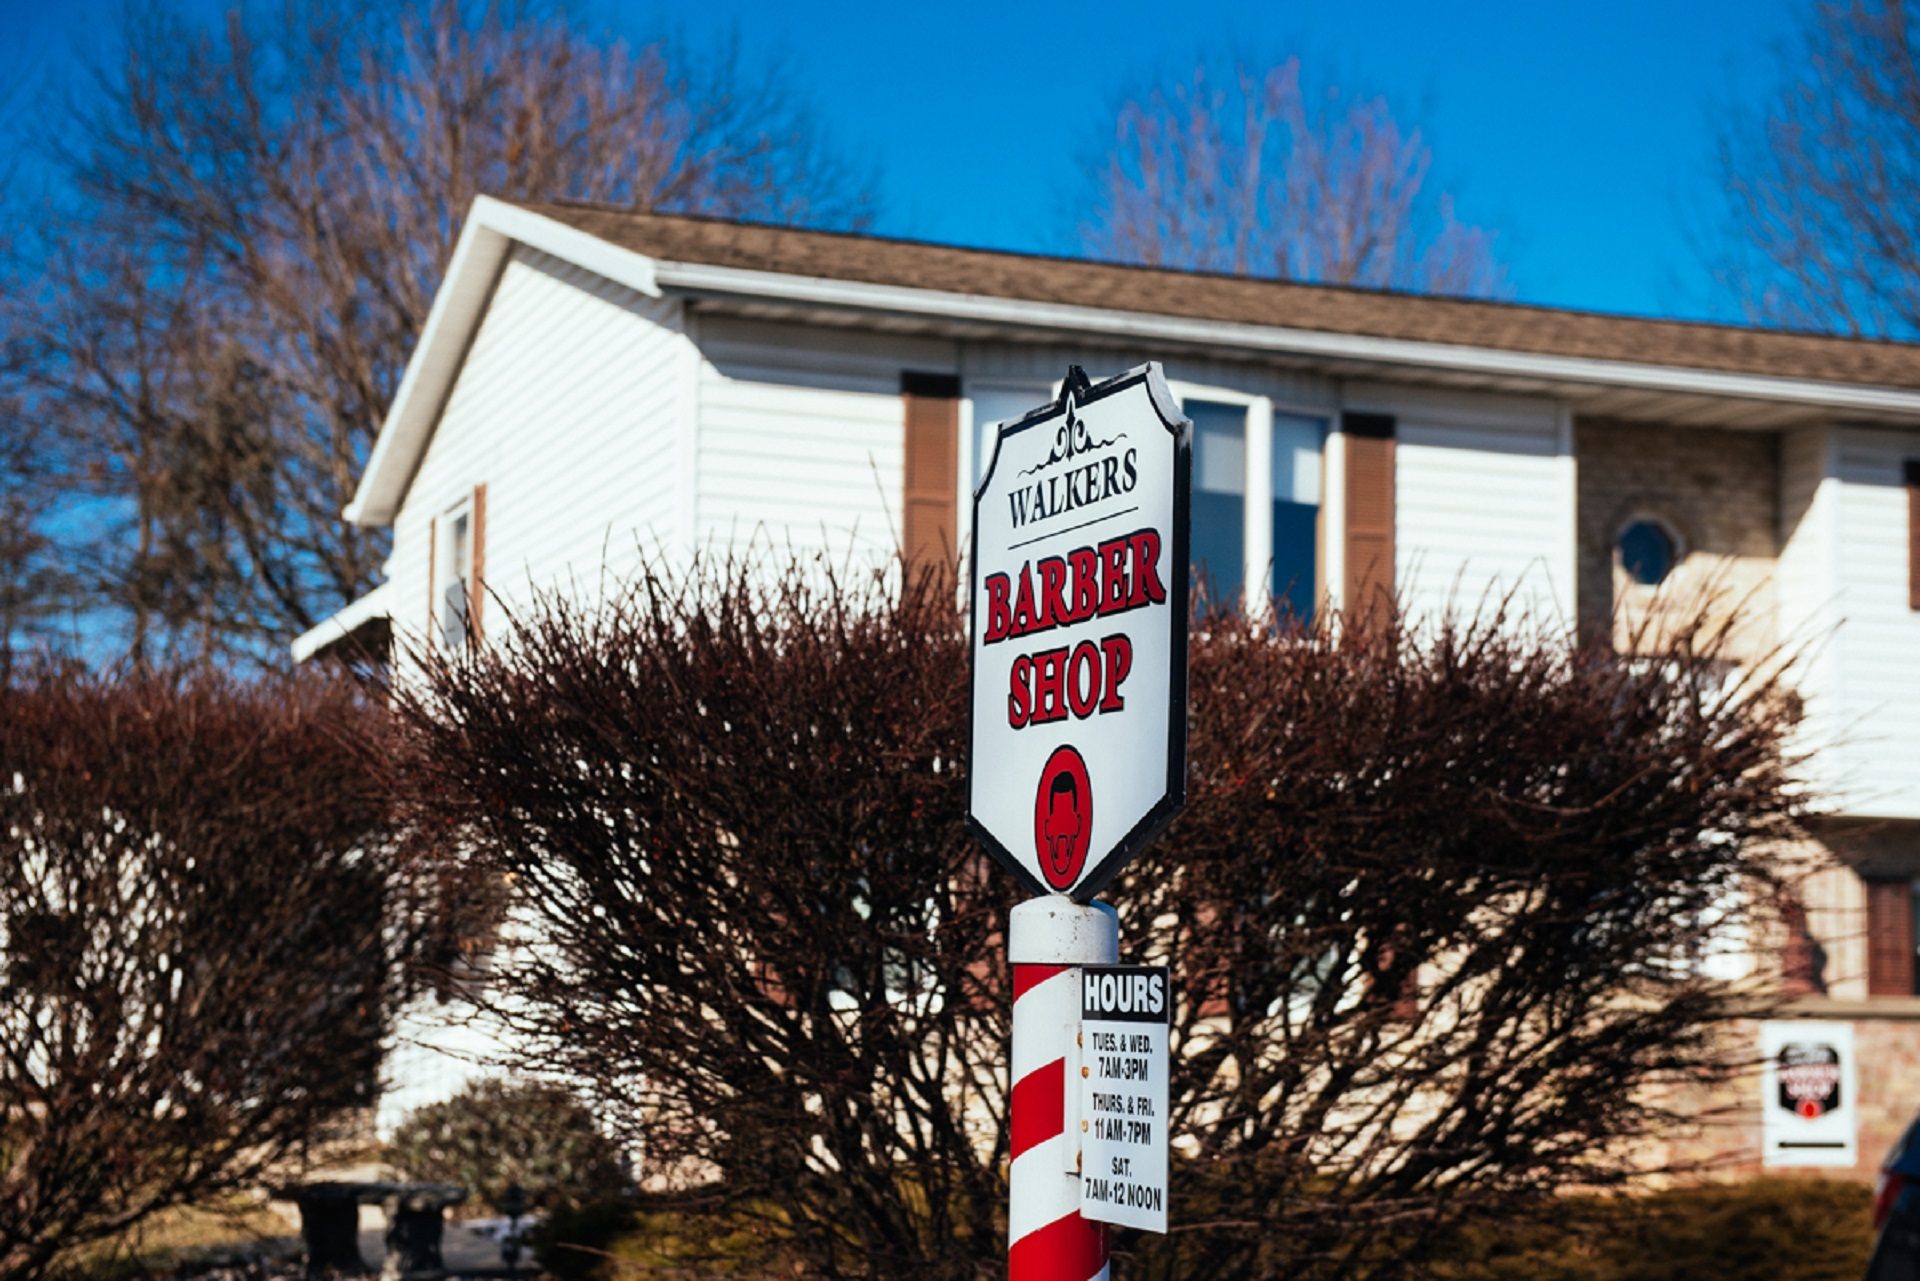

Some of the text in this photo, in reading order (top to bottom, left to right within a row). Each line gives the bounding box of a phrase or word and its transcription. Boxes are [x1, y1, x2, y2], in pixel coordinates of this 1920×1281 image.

[1007, 448, 1138, 529] WALKERS
[984, 527, 1166, 645] BARBER
[1008, 632, 1133, 730] SHOP
[1084, 973, 1164, 1015] HOURS
[1092, 1032, 1153, 1054] TUES. & WED.
[1098, 1057, 1148, 1082] 7AM-3PM
[1092, 1092, 1155, 1117] THURS. & FRI.
[1111, 1156, 1132, 1178] SAT.
[1085, 1177, 1162, 1212] 7AM-12 NOON
